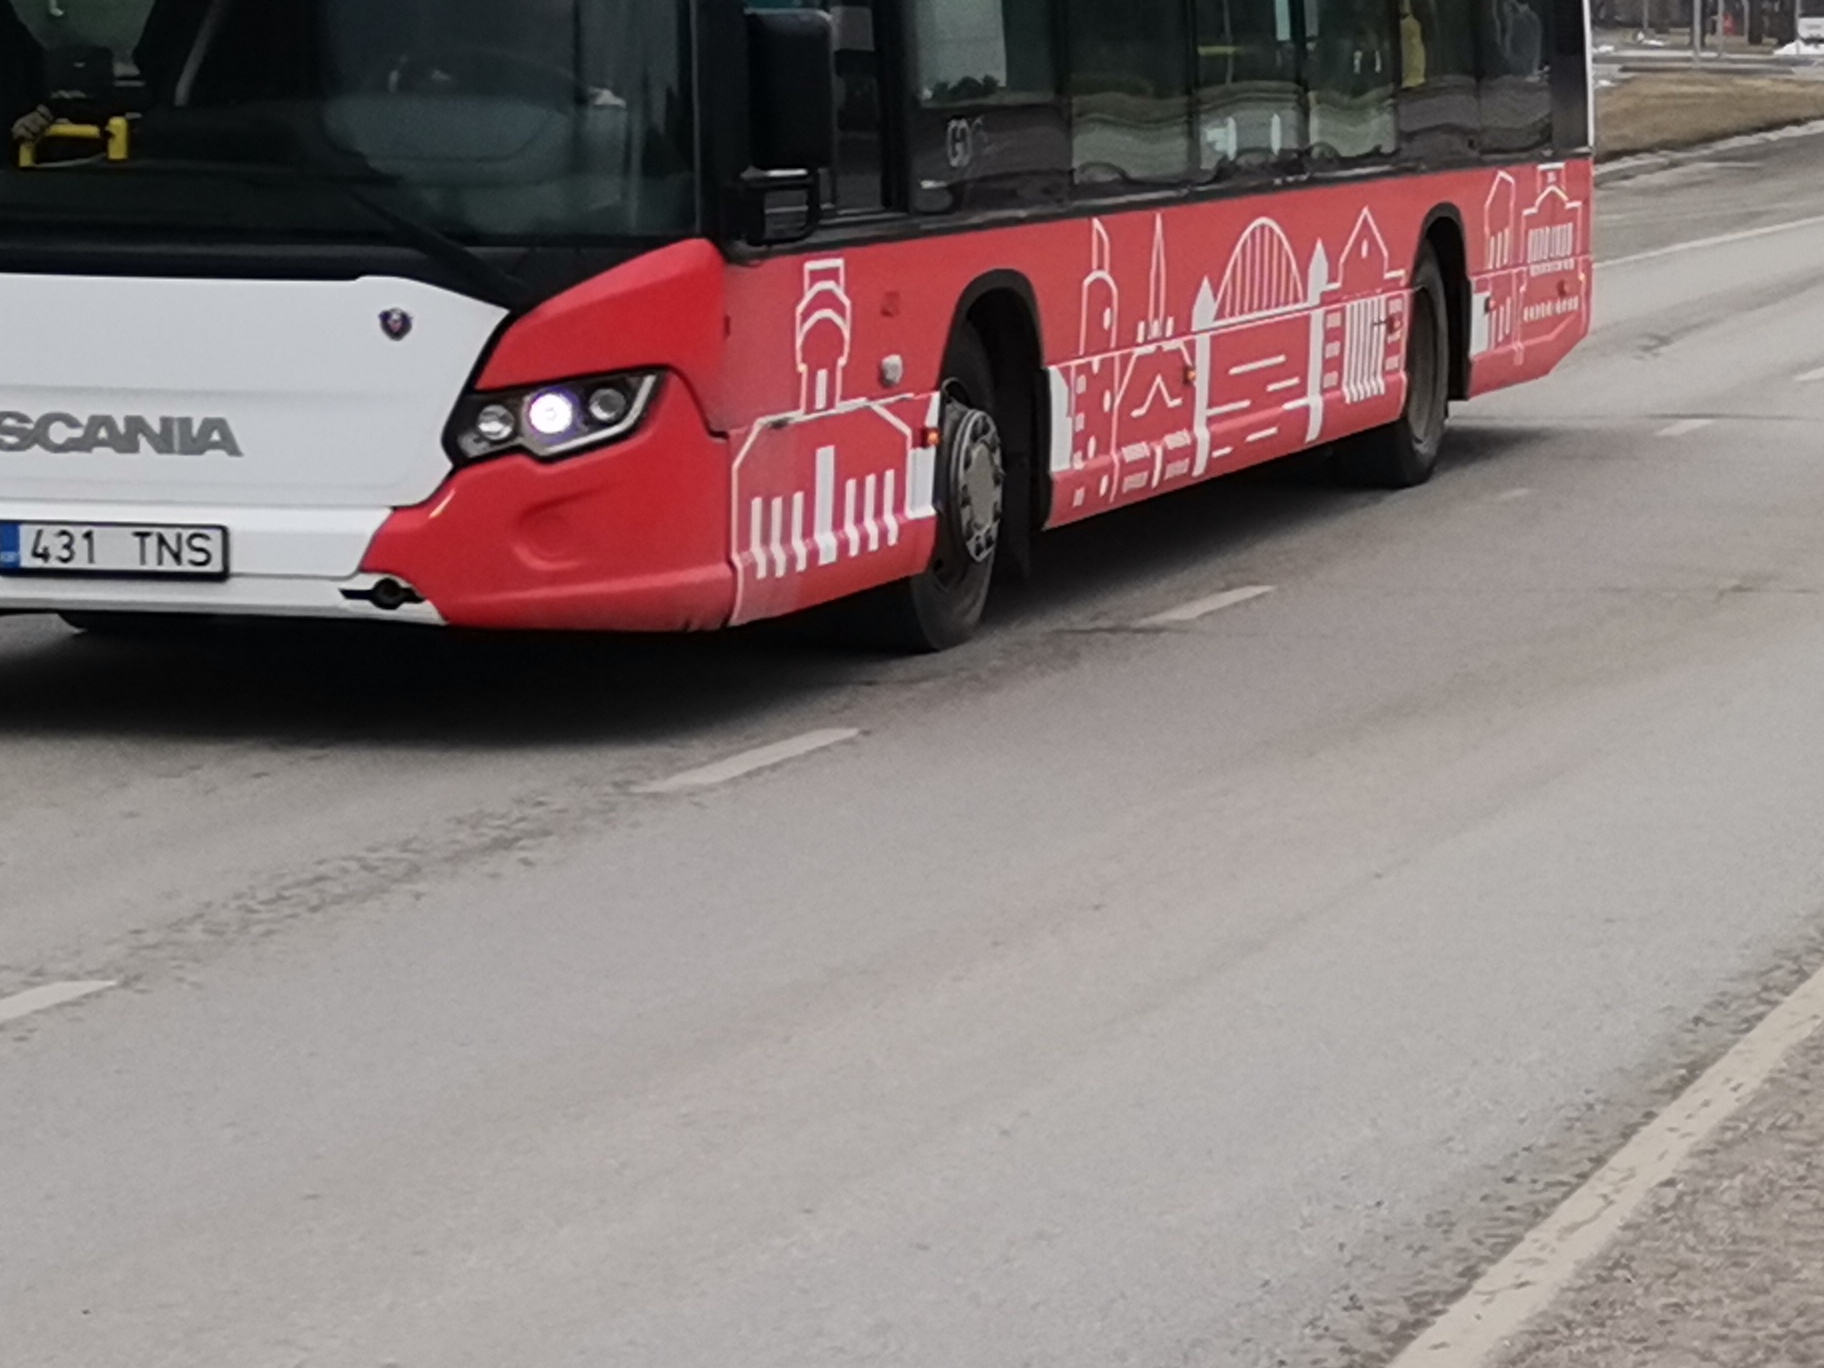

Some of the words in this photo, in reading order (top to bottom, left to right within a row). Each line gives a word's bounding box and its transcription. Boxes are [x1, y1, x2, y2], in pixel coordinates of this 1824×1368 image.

[0, 410, 244, 457] SCANIA
[31, 528, 96, 564] 431
[131, 530, 212, 567] TNS
